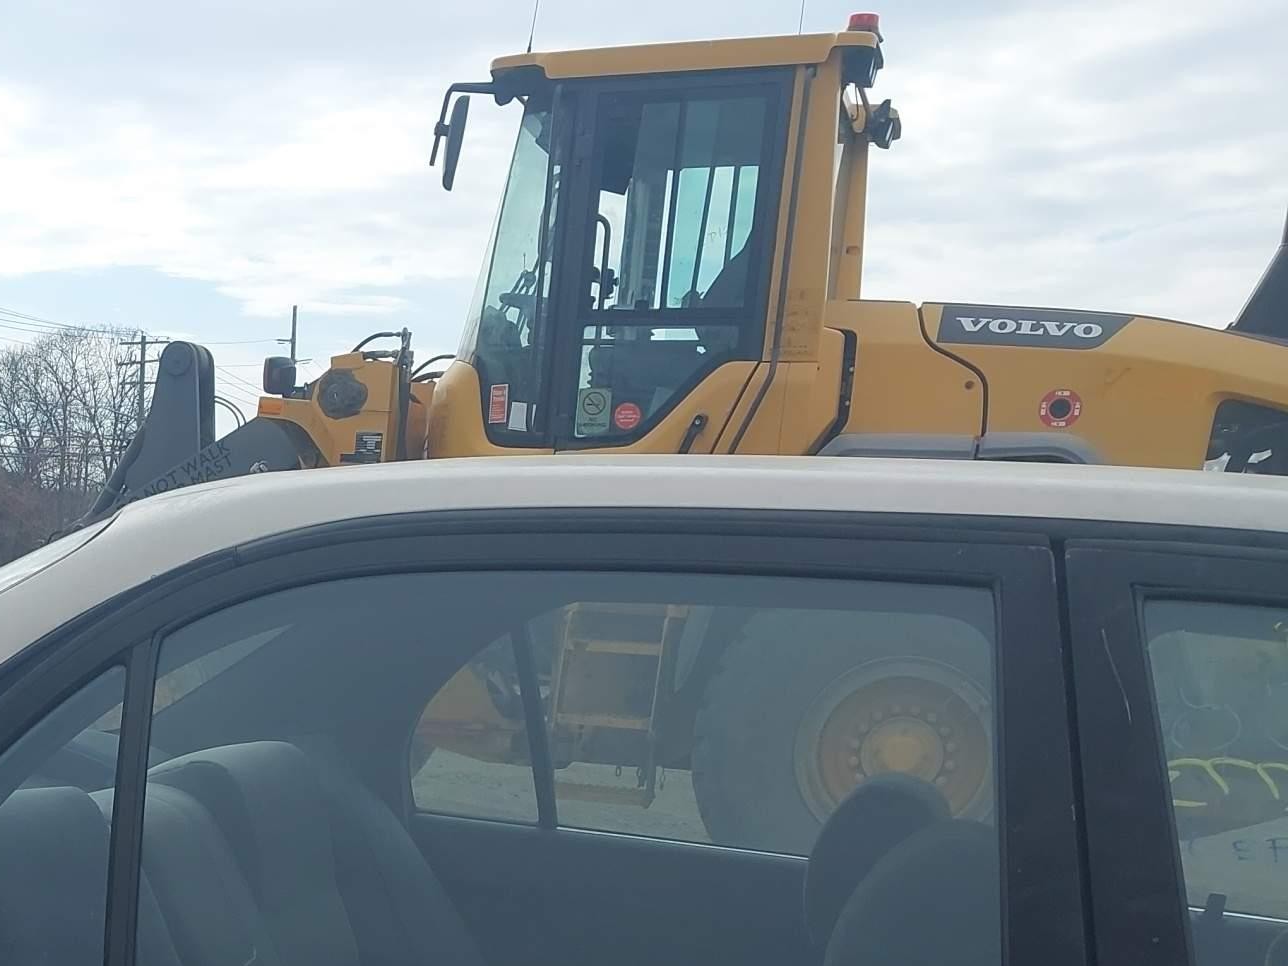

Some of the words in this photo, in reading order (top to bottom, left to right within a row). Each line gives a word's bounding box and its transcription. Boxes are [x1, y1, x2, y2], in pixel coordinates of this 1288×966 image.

[956, 317, 1103, 338] VOLVO
[143, 470, 178, 497] NOT
[180, 441, 231, 475] WALK
